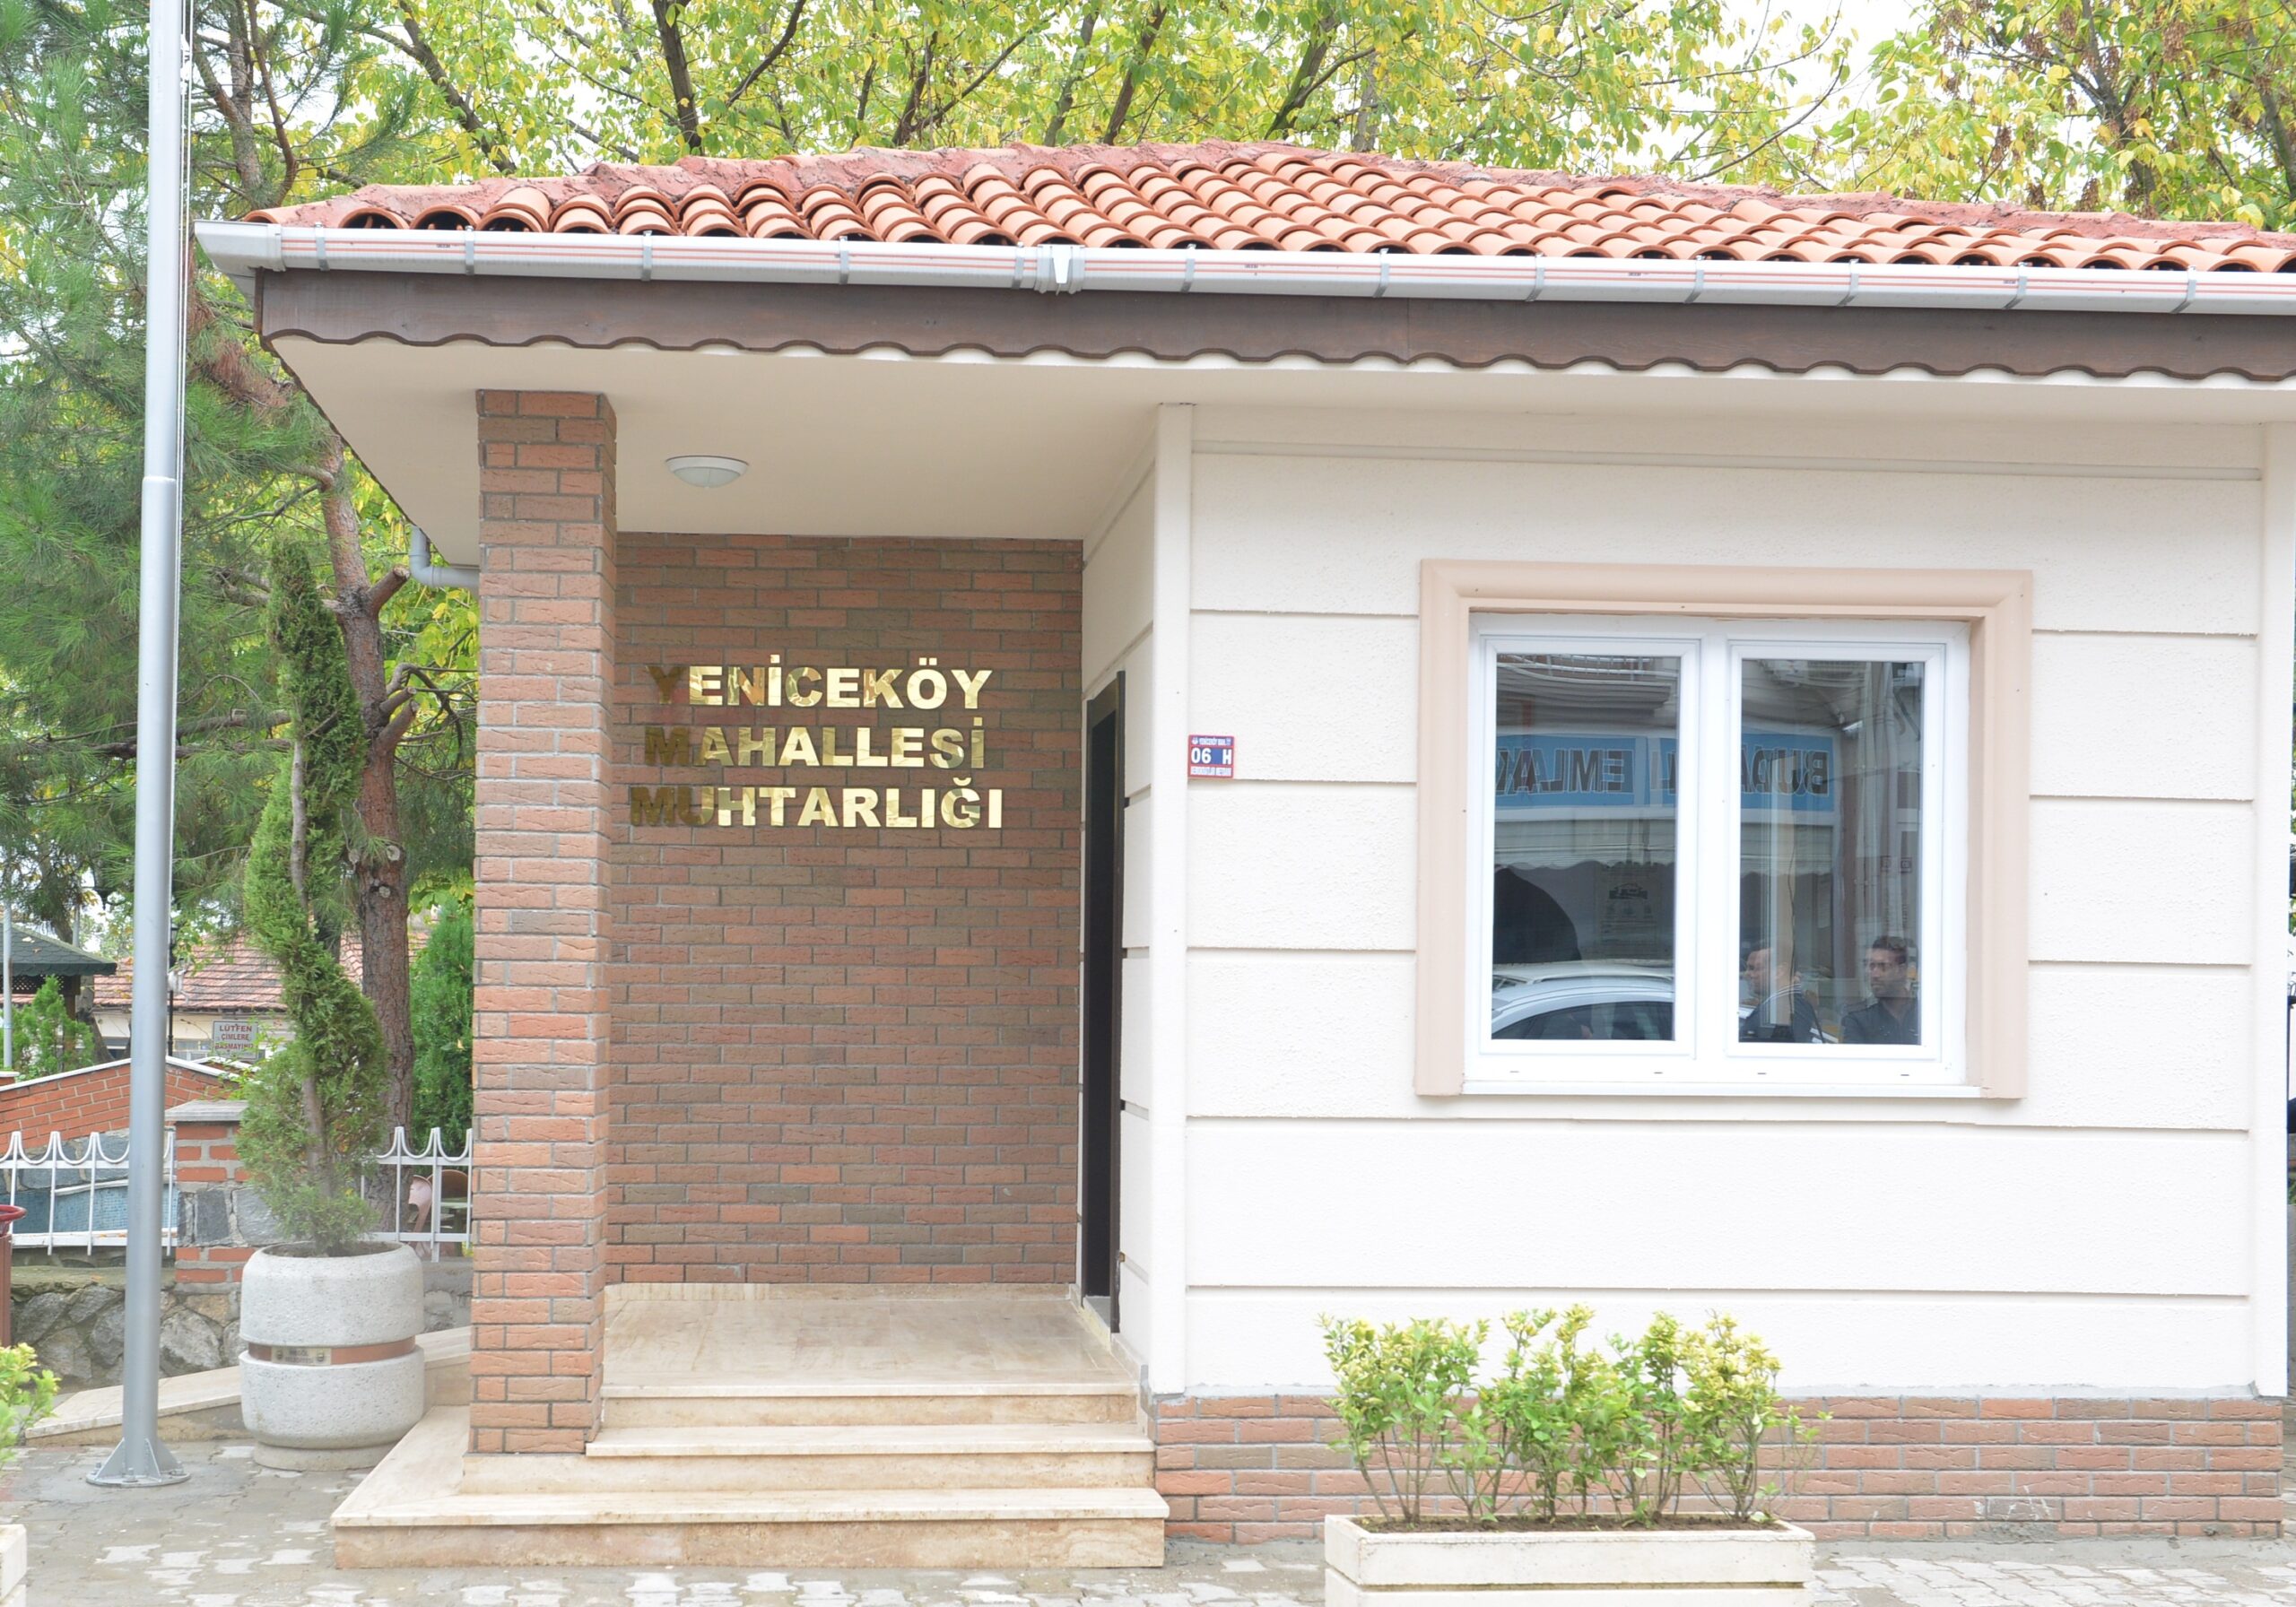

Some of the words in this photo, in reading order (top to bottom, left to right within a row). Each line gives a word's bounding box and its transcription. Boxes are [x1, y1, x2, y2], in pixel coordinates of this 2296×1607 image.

[645, 654, 993, 709] YENİCEKÖY
[644, 717, 985, 769] MAHALLESİ
[1191, 747, 1212, 764] 06
[1222, 748, 1232, 765] H
[630, 777, 1002, 830] MUHTARLIĞI
